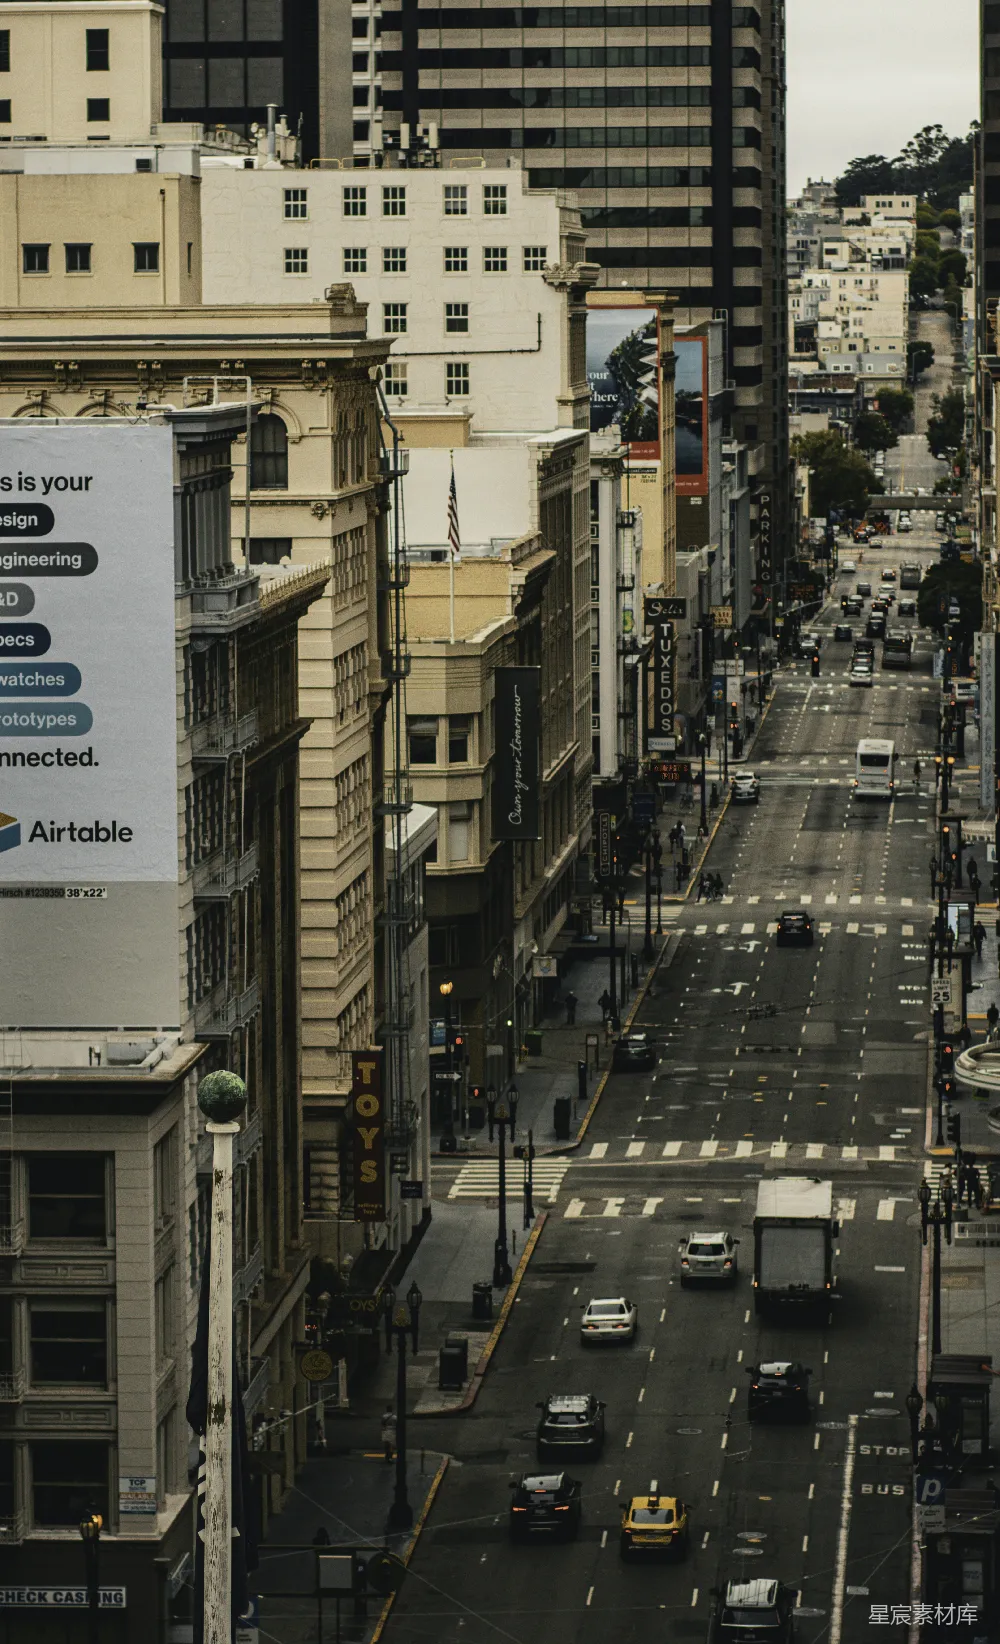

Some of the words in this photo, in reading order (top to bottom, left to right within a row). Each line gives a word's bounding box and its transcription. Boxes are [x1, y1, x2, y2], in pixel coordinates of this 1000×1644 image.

[588, 371, 610, 380] our
[589, 388, 619, 402] here
[18, 471, 37, 492] is
[41, 475, 93, 496] your
[760, 495, 770, 581] PARKING
[0, 551, 82, 569] gineering
[660, 623, 672, 732] TUXEDOS
[0, 711, 77, 729] ototypes
[509, 684, 523, 754] tomorrow
[514, 754, 530, 791] your
[508, 791, 522, 825] Own
[28, 820, 134, 843] Airtable
[66, 888, 107, 898] 38'x22'
[933, 991, 950, 1002] 25
[355, 1061, 380, 1183] TOYS
[351, 1299, 375, 1312] OYS
[859, 1445, 910, 1456] STOP
[861, 1483, 905, 1496] BUS
[52, 1591, 124, 1604] CASING
